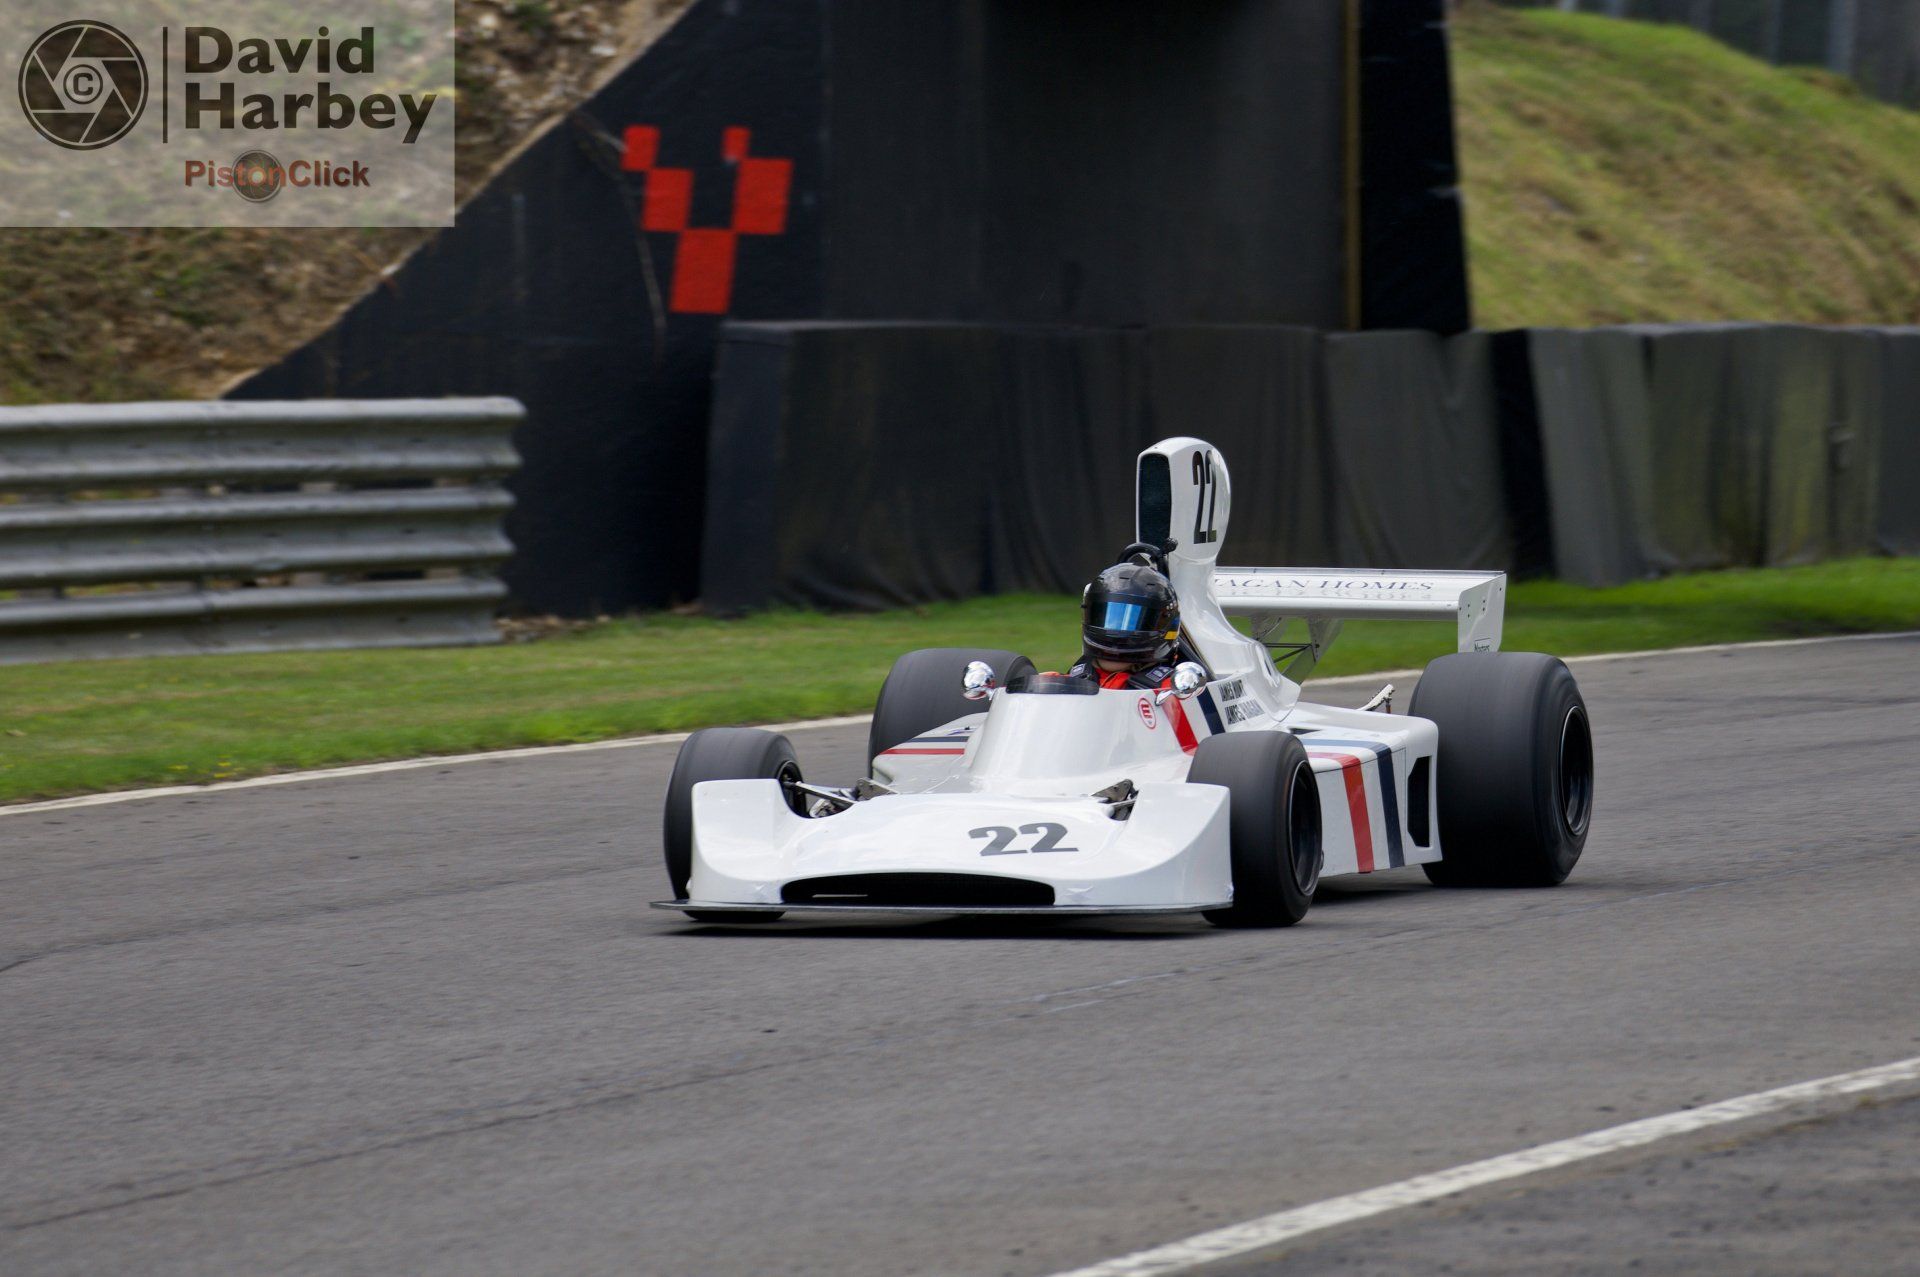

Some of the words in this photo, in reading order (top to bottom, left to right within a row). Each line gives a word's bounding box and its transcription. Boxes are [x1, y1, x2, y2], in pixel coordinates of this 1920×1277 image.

[1191, 449, 1218, 545] 22
[1213, 578, 1310, 589] AGAN
[1319, 579, 1434, 591] HOMES
[968, 822, 1079, 857] 22
